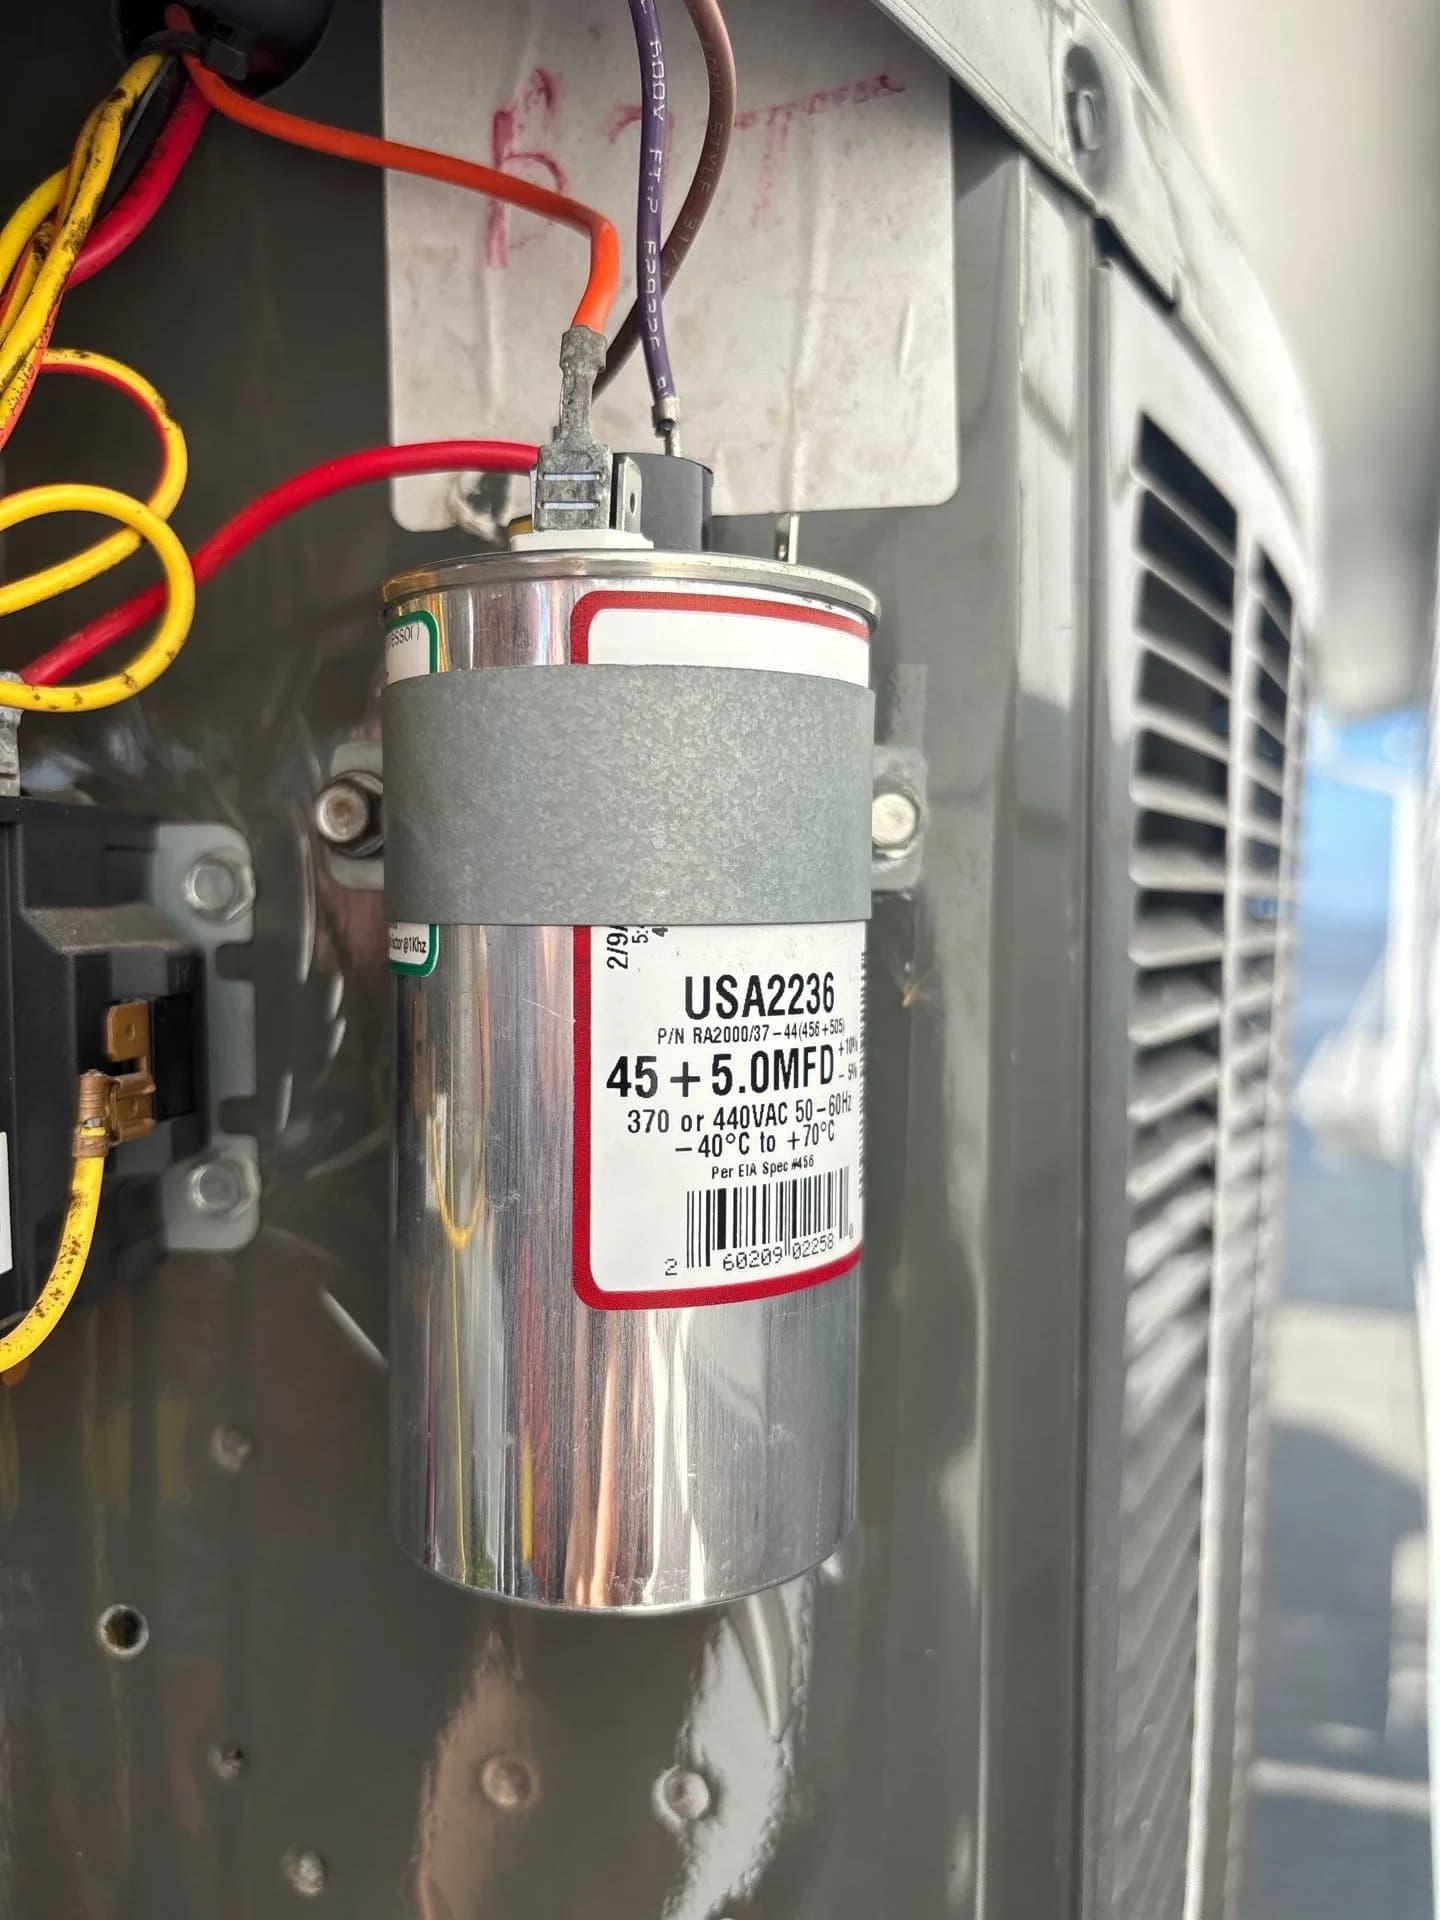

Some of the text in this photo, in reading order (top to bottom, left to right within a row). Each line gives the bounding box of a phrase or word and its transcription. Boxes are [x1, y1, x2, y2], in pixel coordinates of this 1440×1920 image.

[684, 971, 835, 1020] USA2236
[656, 1026, 685, 1045] P/N
[627, 1108, 670, 1133] 370
[680, 1113, 705, 1132] or
[712, 1101, 788, 1131] 440VAC
[759, 1132, 777, 1153] to
[711, 1154, 815, 1180] Per EIA Spec #456
[663, 1258, 679, 1276] 2
[721, 1246, 784, 1272] 60209
[791, 1232, 835, 1260] 02258
